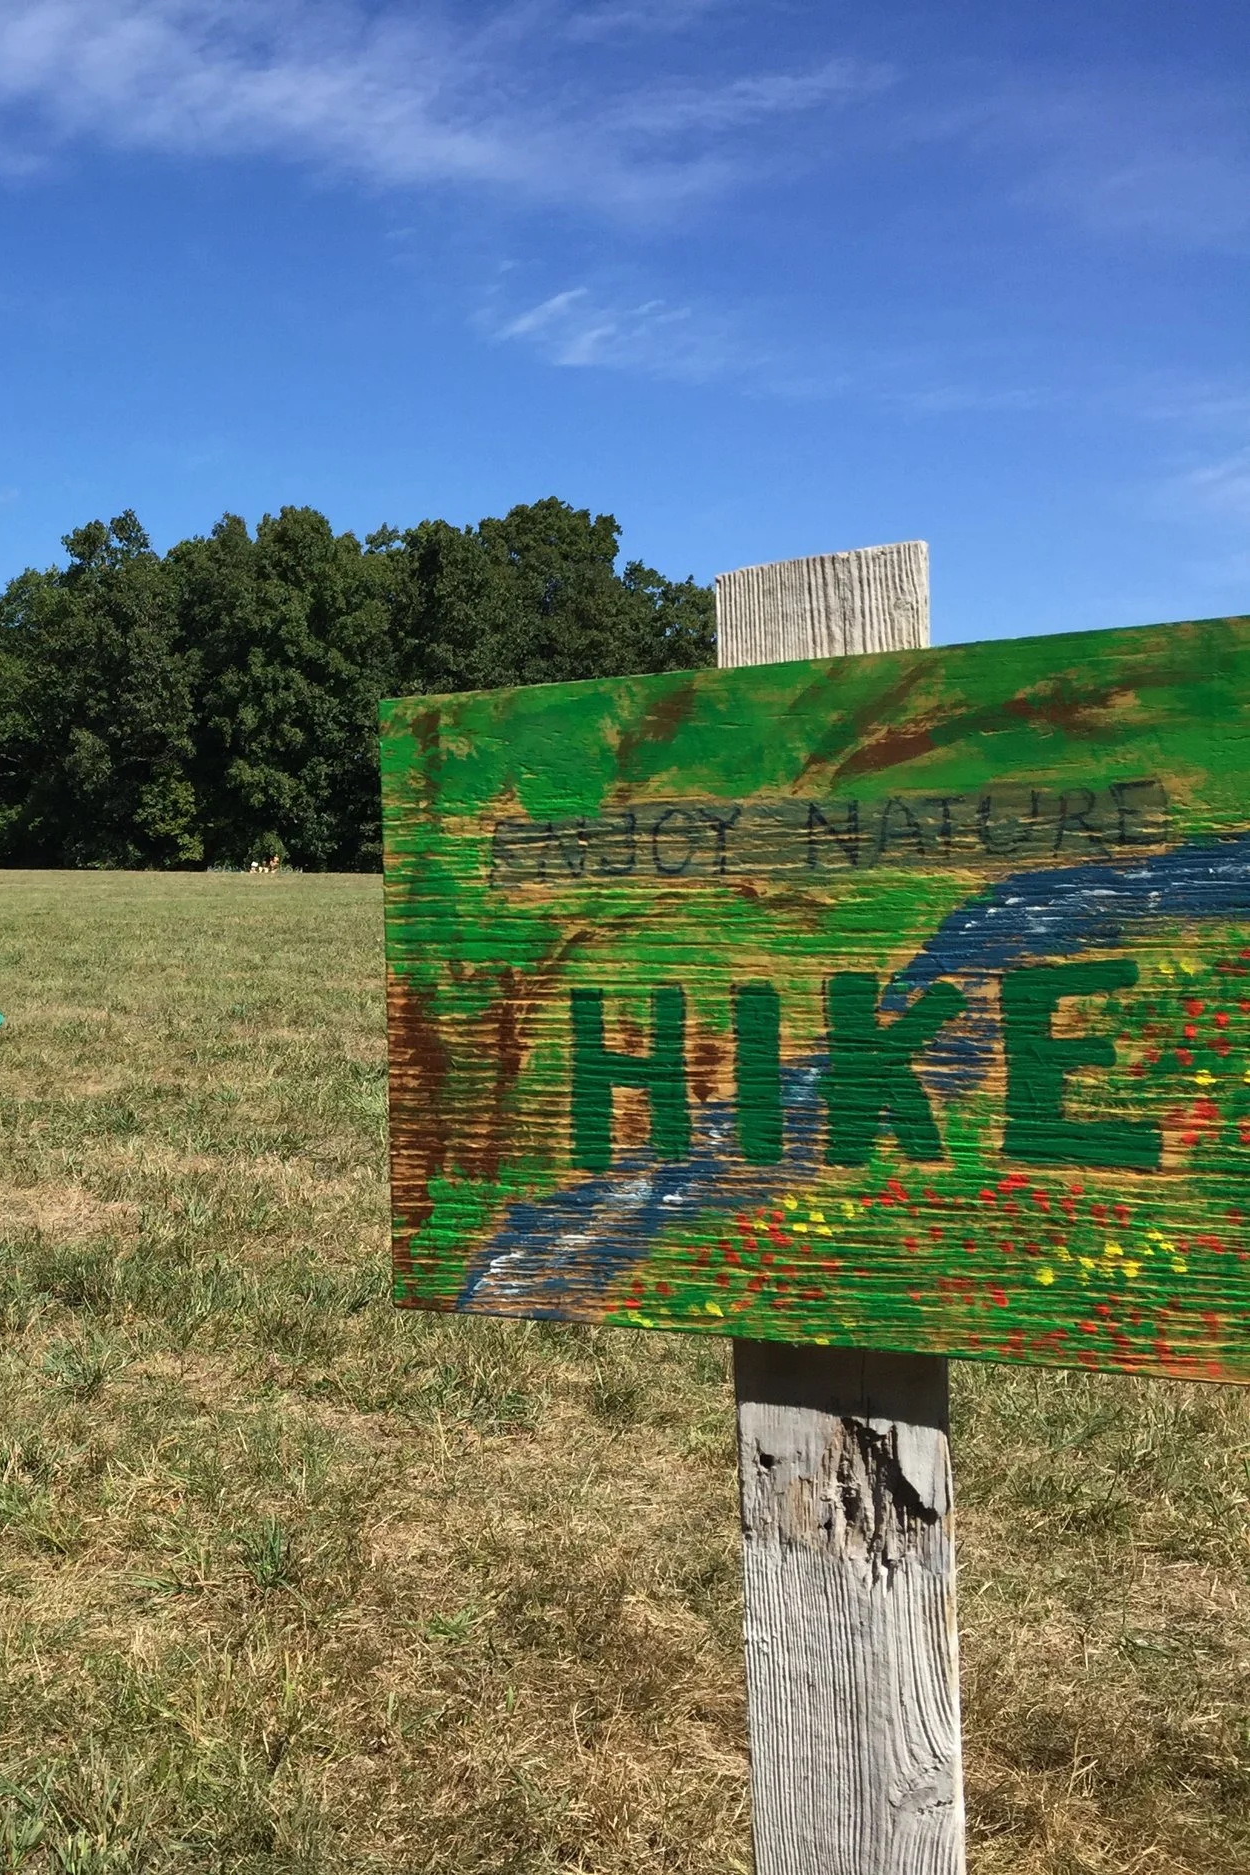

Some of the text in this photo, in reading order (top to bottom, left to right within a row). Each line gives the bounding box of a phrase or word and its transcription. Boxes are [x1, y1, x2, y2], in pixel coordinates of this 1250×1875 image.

[490, 780, 1168, 888] ENJOY NATURE
[570, 959, 1162, 1173] HIKE
